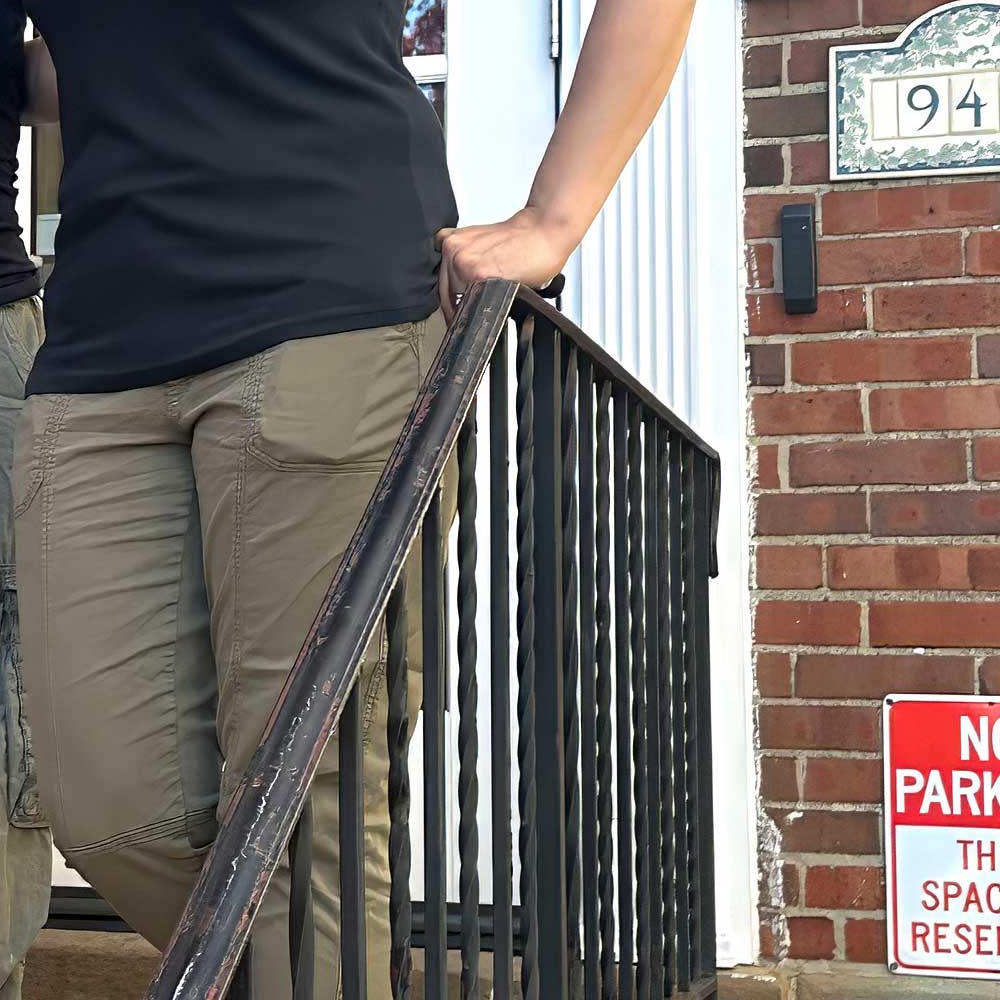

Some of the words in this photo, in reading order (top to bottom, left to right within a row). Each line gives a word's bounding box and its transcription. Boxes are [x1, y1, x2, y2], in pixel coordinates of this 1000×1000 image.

[907, 78, 988, 132] 94
[956, 839, 996, 871] TH
[921, 880, 1000, 914] SPAC
[911, 921, 1000, 956] RESE
